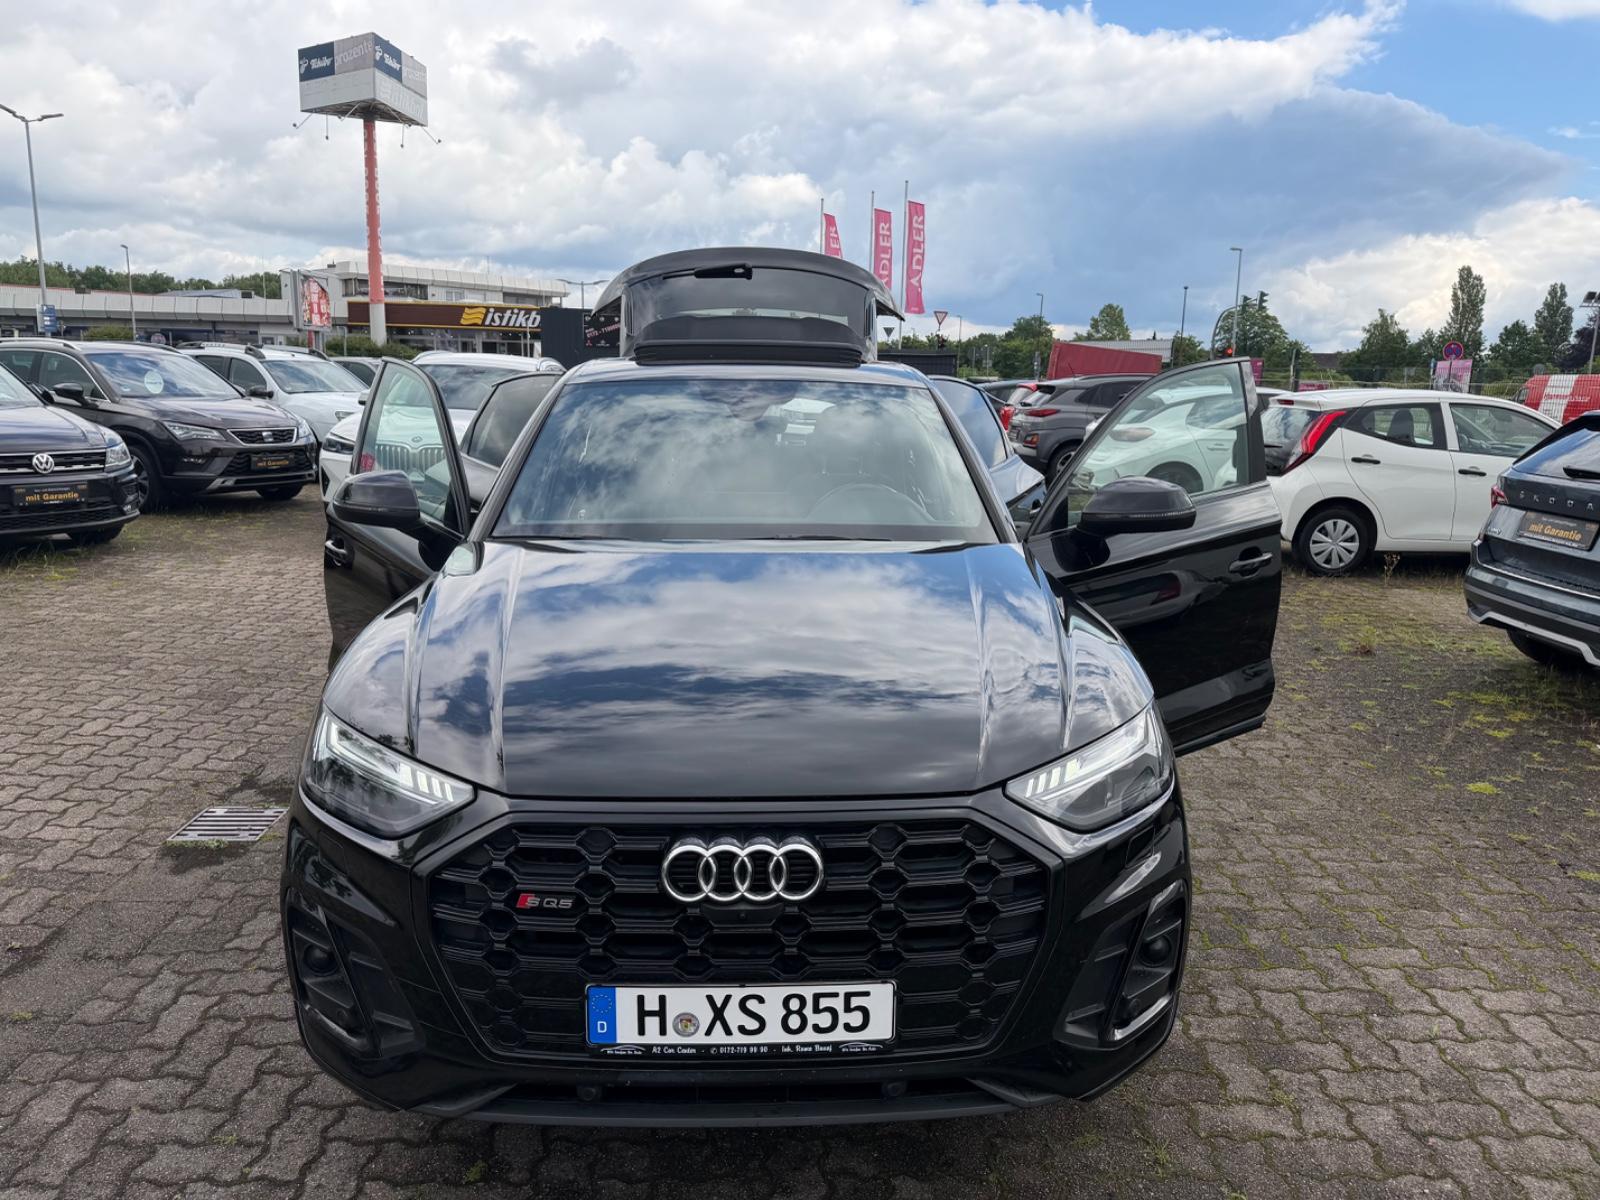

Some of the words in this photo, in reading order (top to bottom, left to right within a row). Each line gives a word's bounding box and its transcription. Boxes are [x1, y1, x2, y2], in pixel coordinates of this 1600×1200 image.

[910, 215, 924, 292] ADLER
[485, 308, 541, 328] istikb
[25, 493, 41, 502] mit
[42, 491, 79, 501] Garantie
[1528, 522, 1545, 533] mit
[1544, 525, 1582, 541] Garantie
[636, 994, 668, 1037] H
[704, 994, 767, 1037] XS
[780, 991, 872, 1035] 855
[597, 1021, 607, 1034] D
